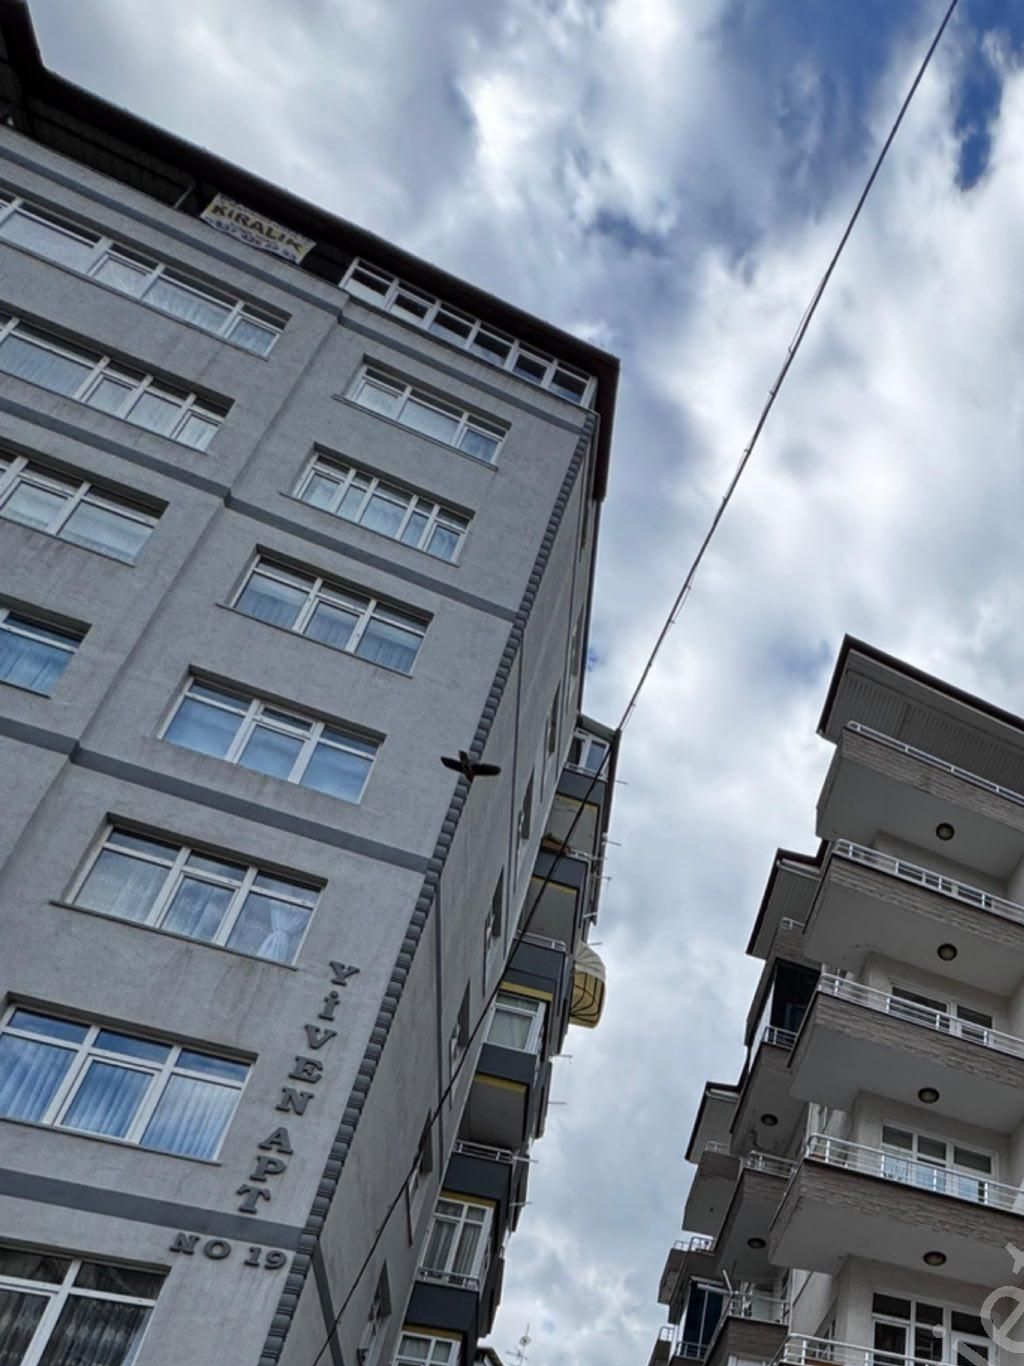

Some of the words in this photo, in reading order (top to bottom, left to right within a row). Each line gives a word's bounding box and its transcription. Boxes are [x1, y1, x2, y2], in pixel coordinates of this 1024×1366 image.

[236, 1126, 293, 1214] APT
[169, 1232, 232, 1260] NO
[244, 1246, 287, 1270] 19
